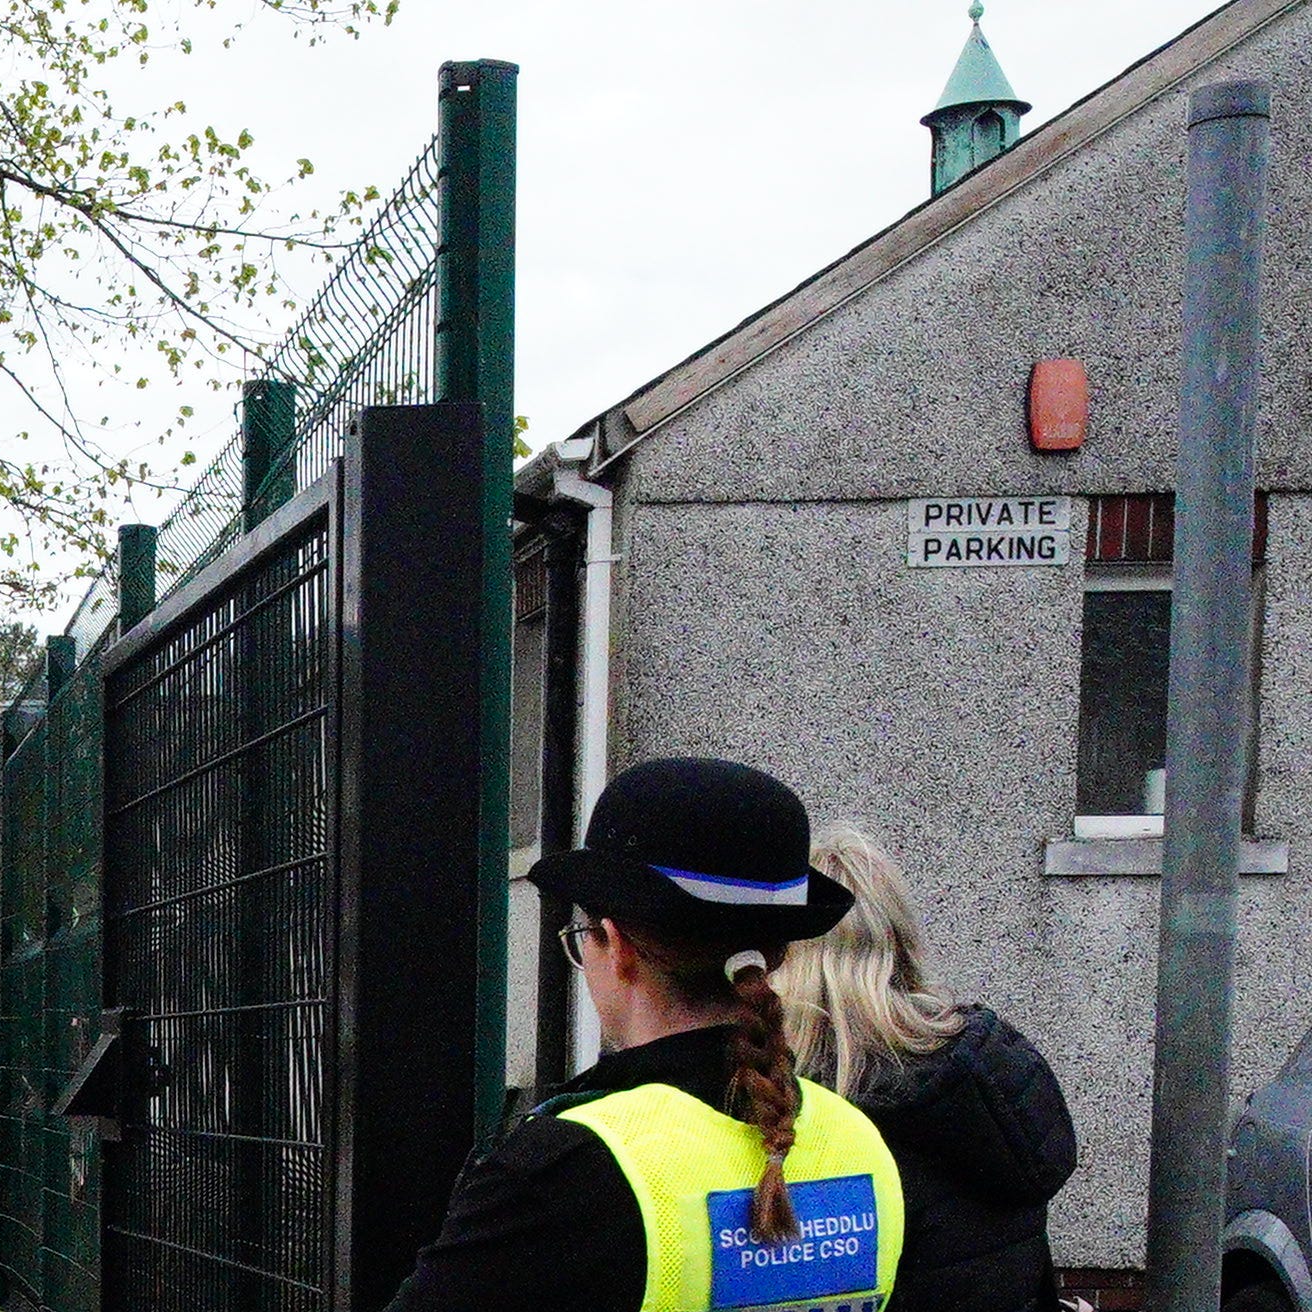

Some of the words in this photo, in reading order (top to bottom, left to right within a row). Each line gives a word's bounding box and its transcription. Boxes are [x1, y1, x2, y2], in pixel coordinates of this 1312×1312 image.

[924, 500, 1057, 527] PRIVATE
[923, 535, 1056, 562] PARKING
[799, 1212, 875, 1239] HEDDLU
[741, 1243, 815, 1268] POLICE
[820, 1237, 859, 1259] CSO
